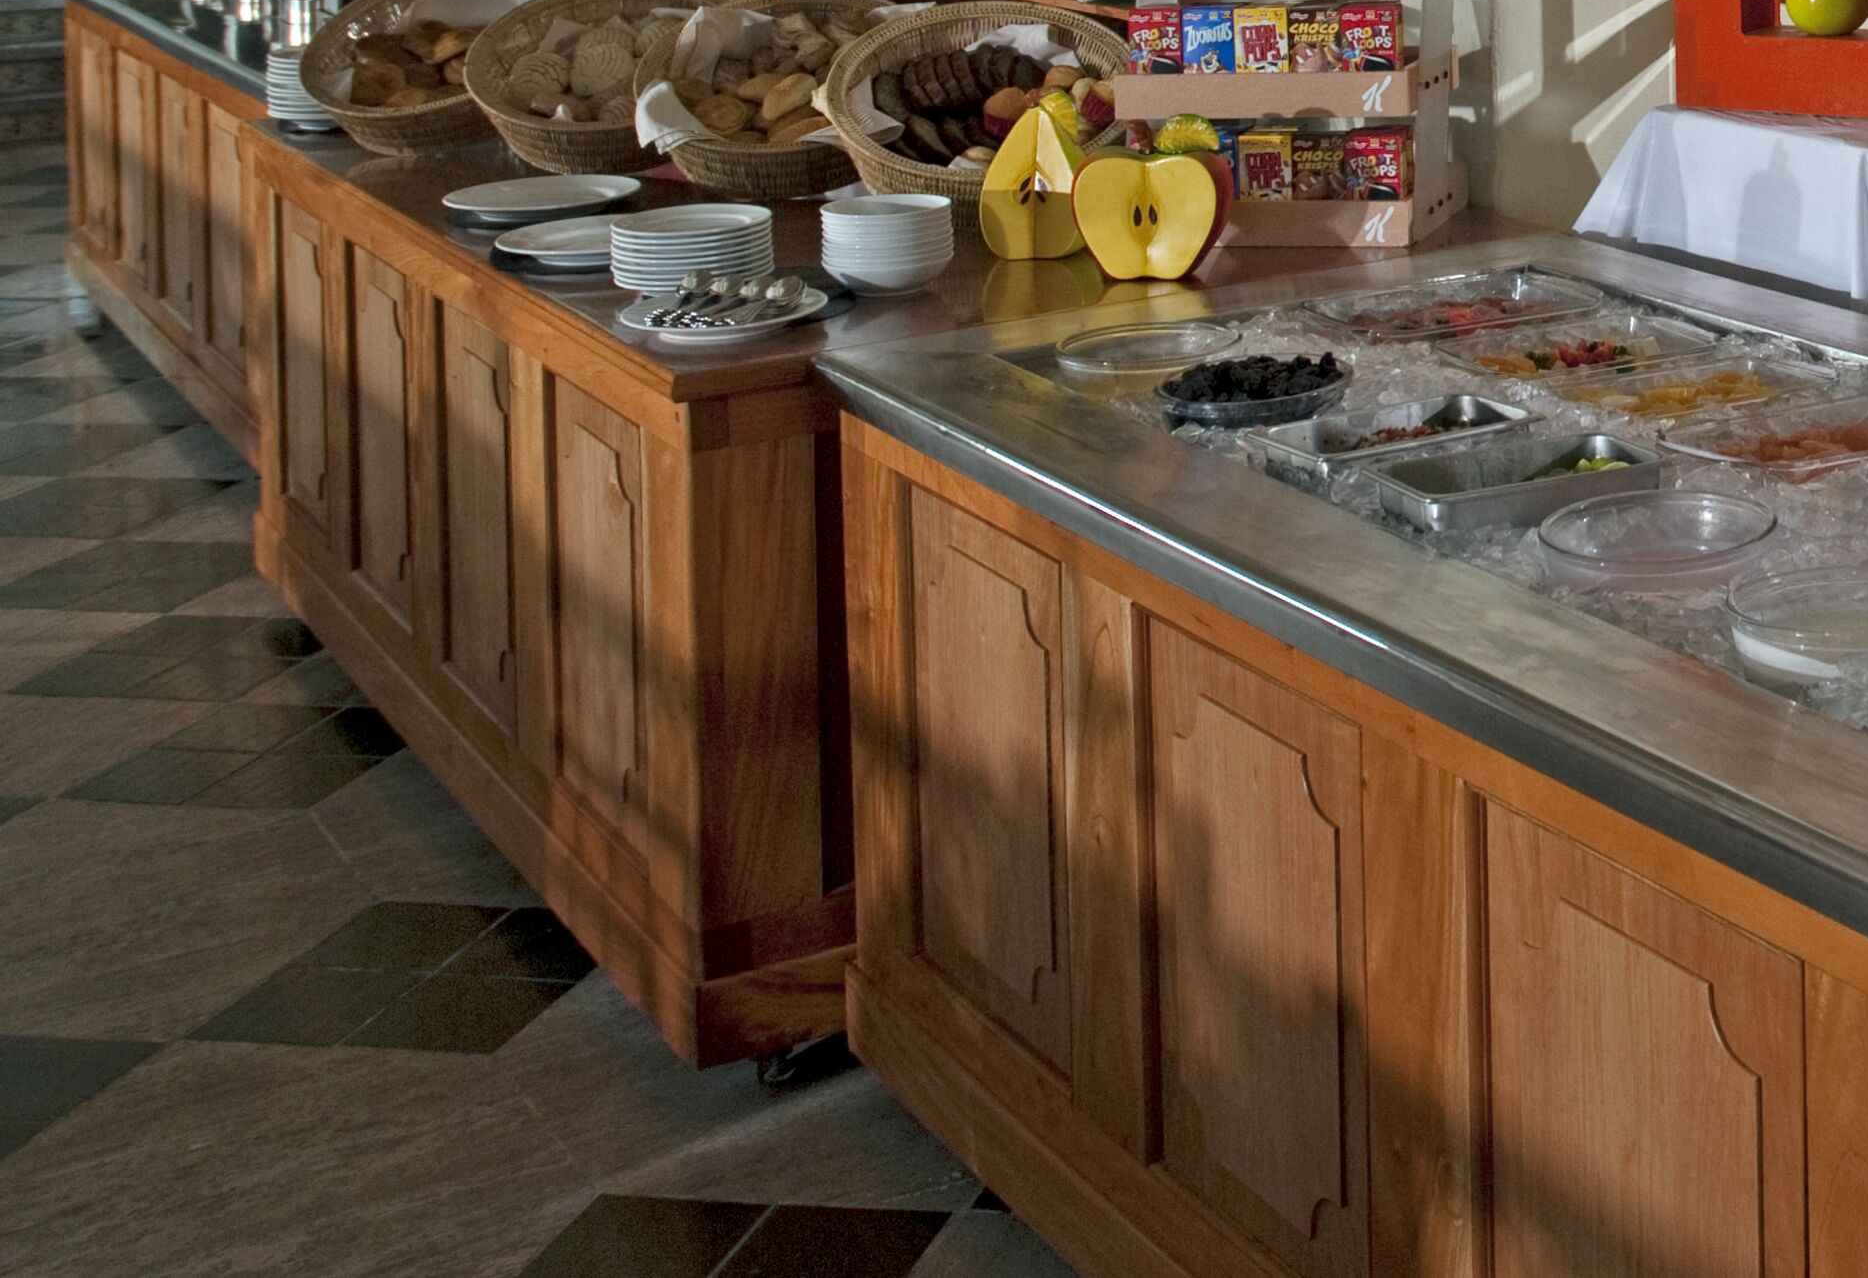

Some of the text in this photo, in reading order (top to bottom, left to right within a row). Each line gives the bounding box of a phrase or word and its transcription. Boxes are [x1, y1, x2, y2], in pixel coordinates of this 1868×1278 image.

[1289, 23, 1340, 34] CHOCO
[1140, 37, 1179, 50] LOOPS
[1352, 37, 1392, 49] LOOPS
[1361, 75, 1392, 112] K
[1293, 150, 1344, 162] CHOCO
[1364, 206, 1394, 243] K
